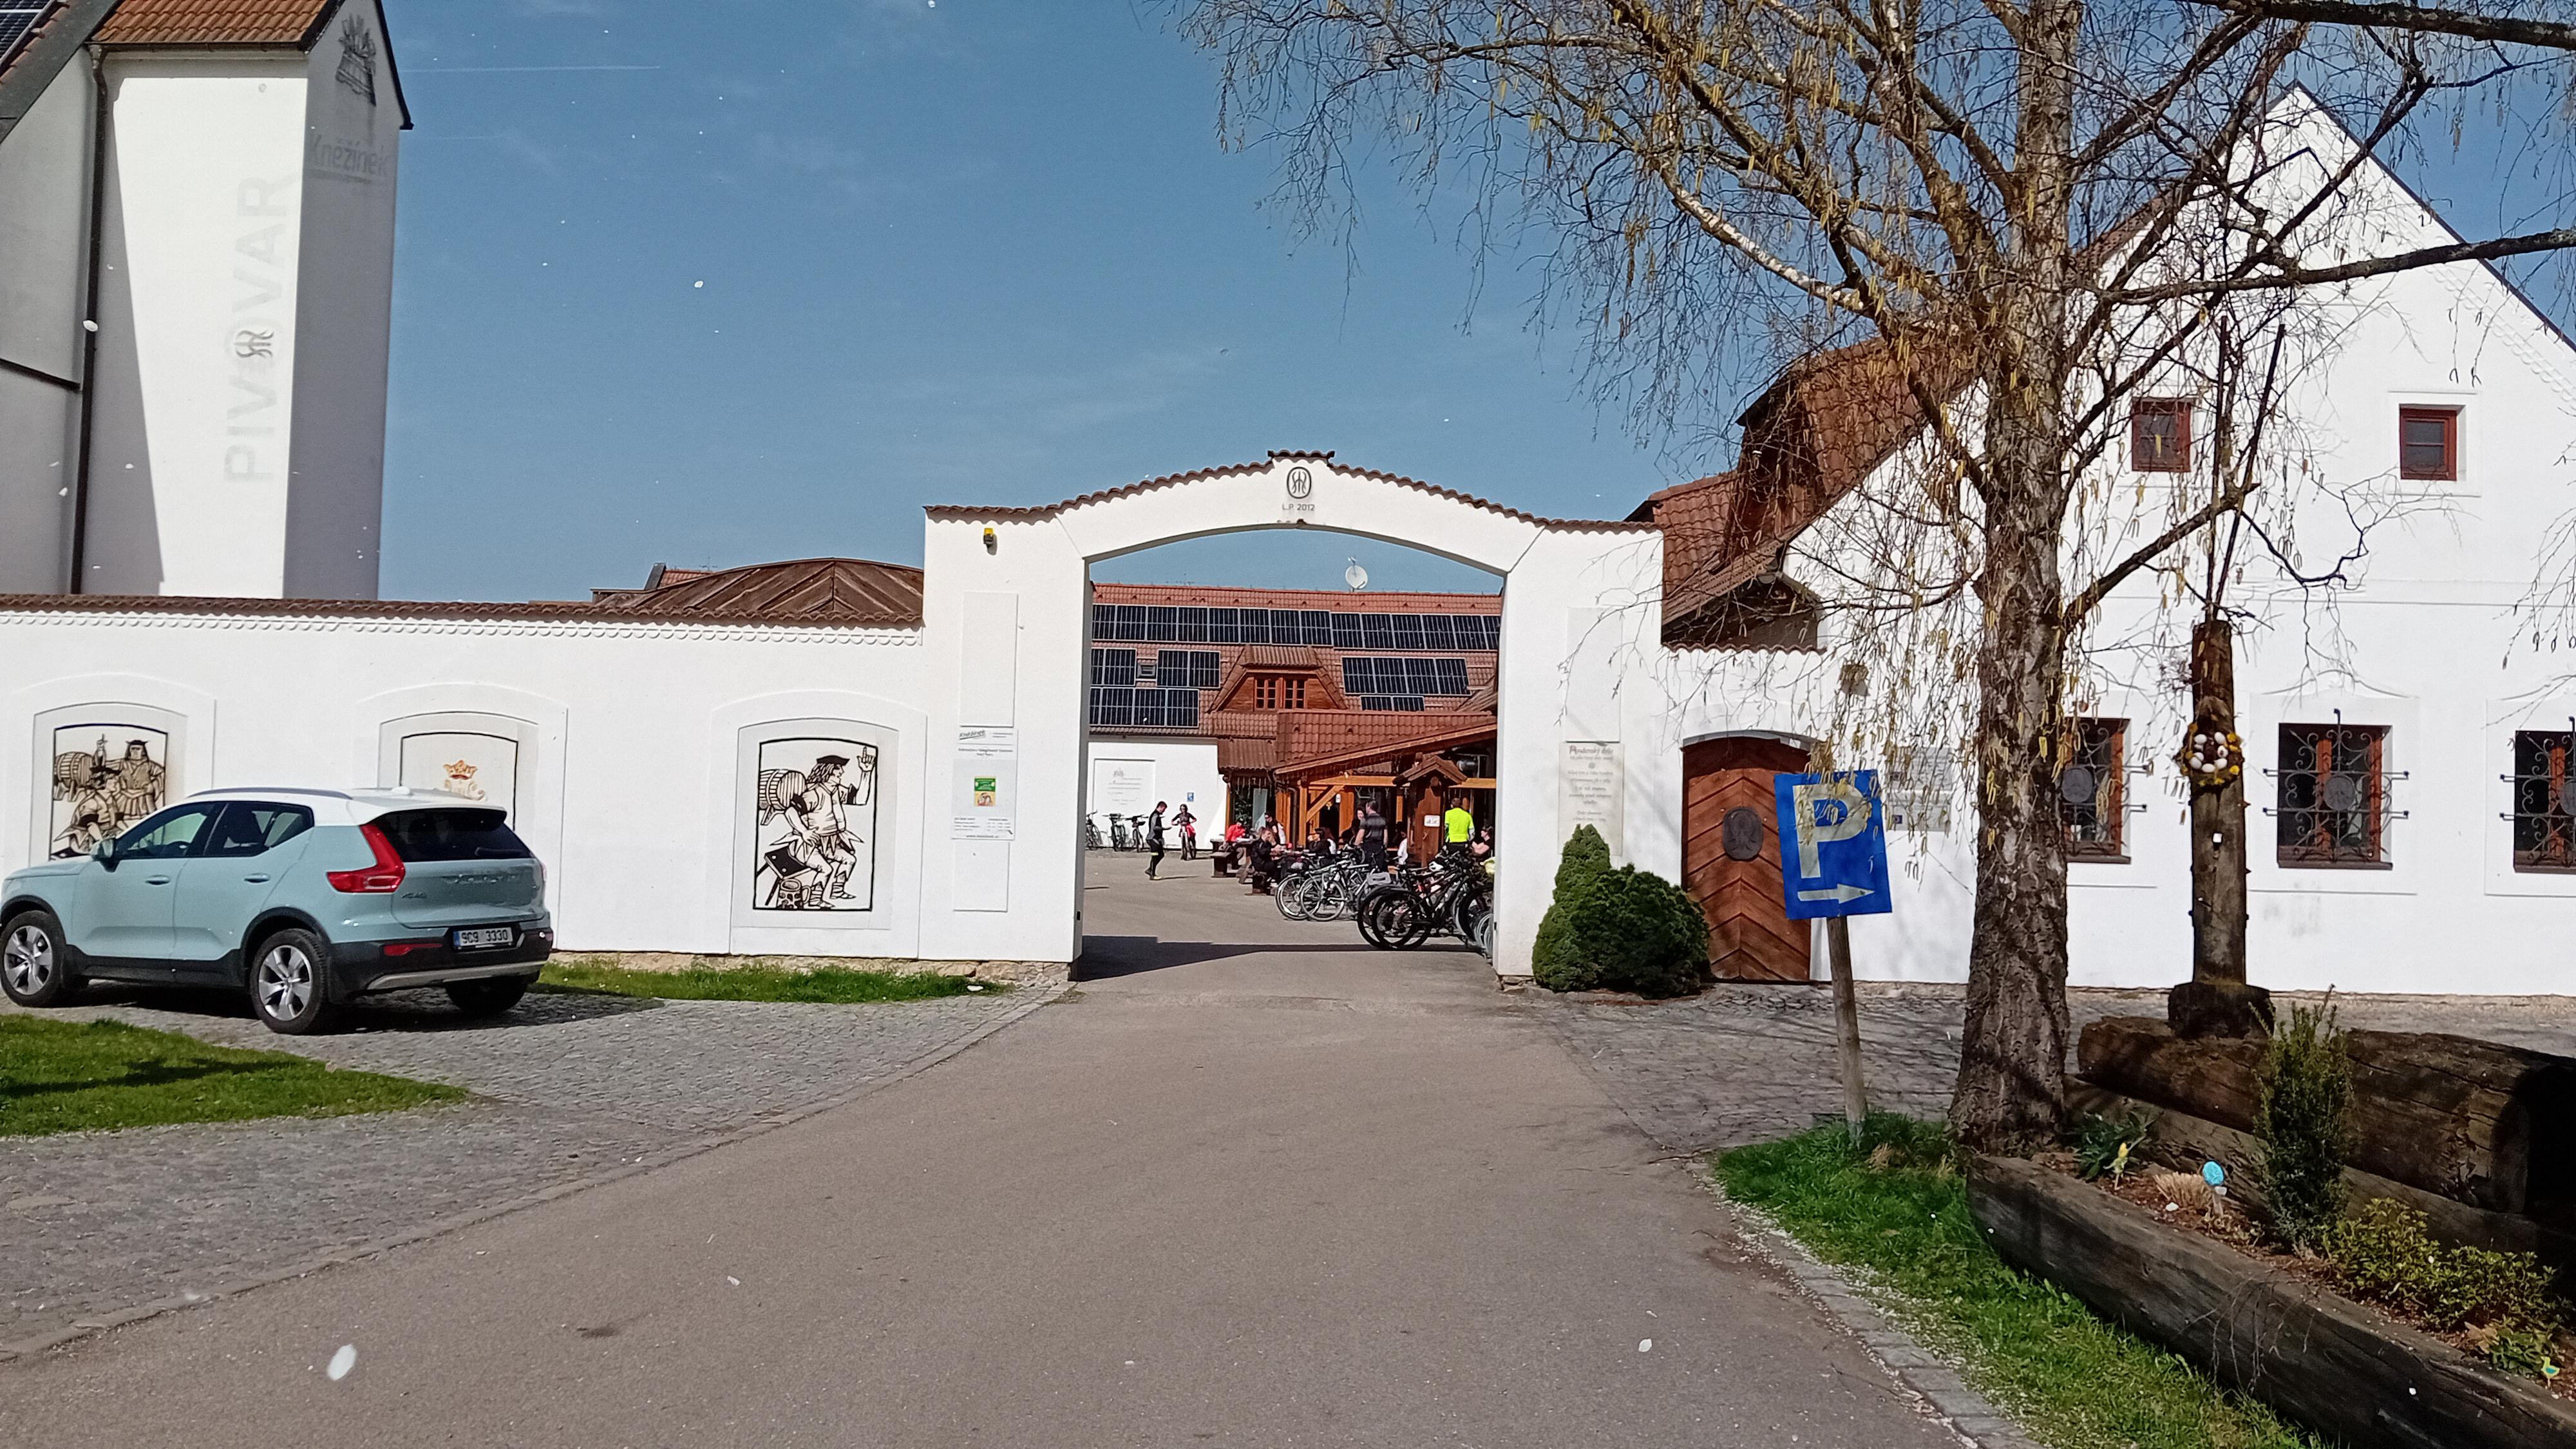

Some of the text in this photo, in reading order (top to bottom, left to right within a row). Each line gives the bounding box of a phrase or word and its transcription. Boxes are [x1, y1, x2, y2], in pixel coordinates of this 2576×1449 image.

[223, 173, 301, 483] PIVOVAR
[1792, 784, 1867, 879] P
[461, 929, 508, 943] 9C9 3330
